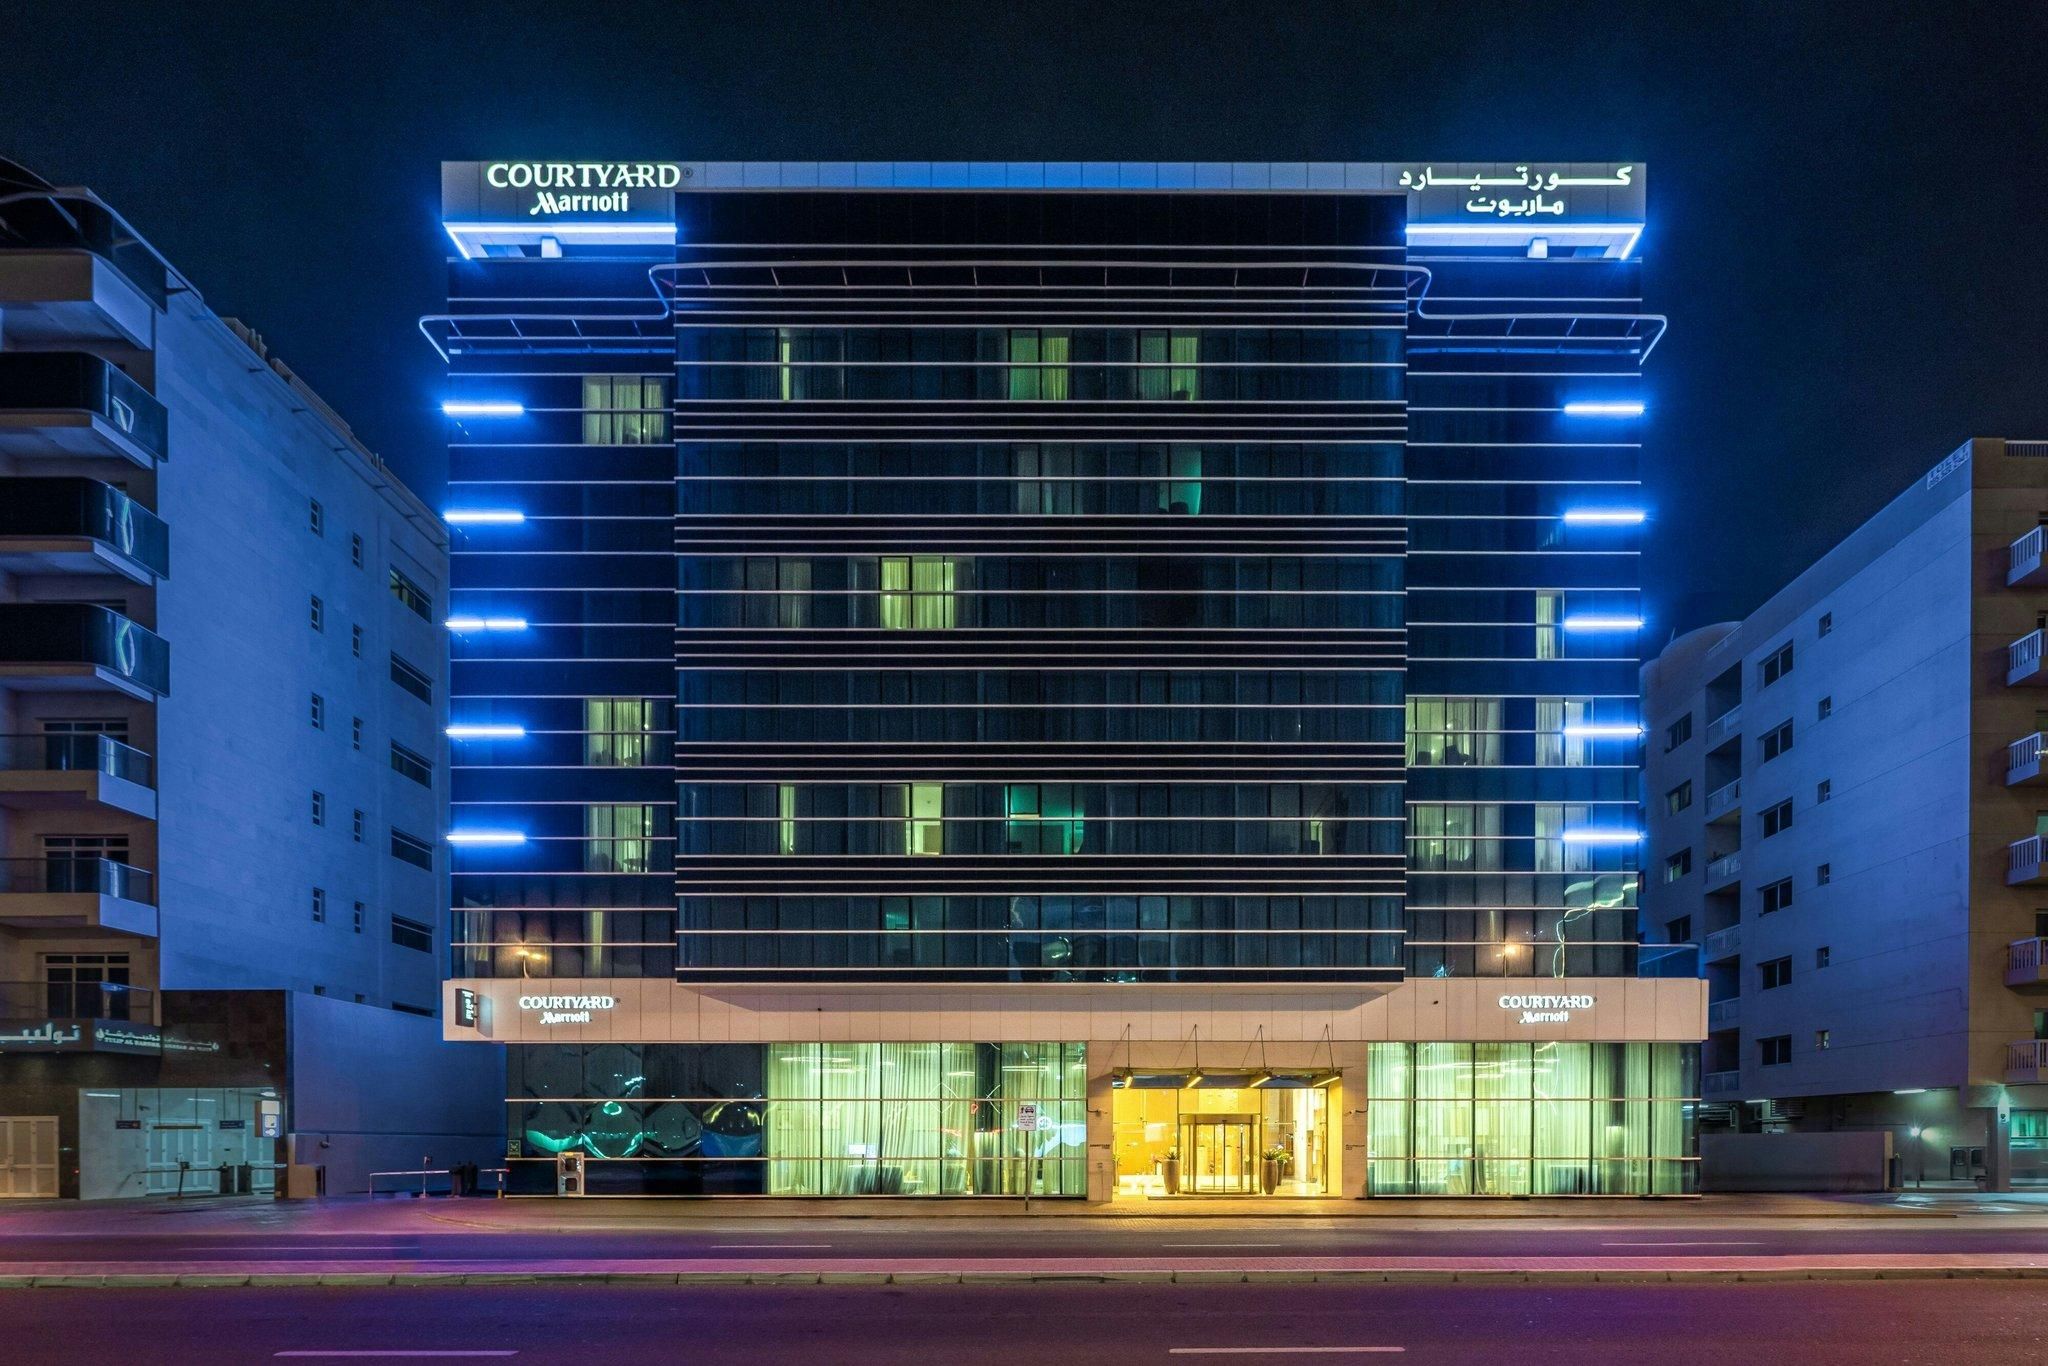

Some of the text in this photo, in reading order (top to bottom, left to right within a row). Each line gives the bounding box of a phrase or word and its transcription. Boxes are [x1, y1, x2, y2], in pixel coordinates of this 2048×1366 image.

[486, 163, 681, 188] COURTYARD
[1399, 165, 1633, 191] كورتيارد
[529, 191, 629, 216] Marriott
[1466, 194, 1565, 217] ماريوت
[519, 995, 614, 1009] COURTYARD
[1498, 995, 1594, 1009] COURTYARD
[540, 1011, 590, 1024] Marriott
[1519, 1011, 1569, 1024] Marriott
